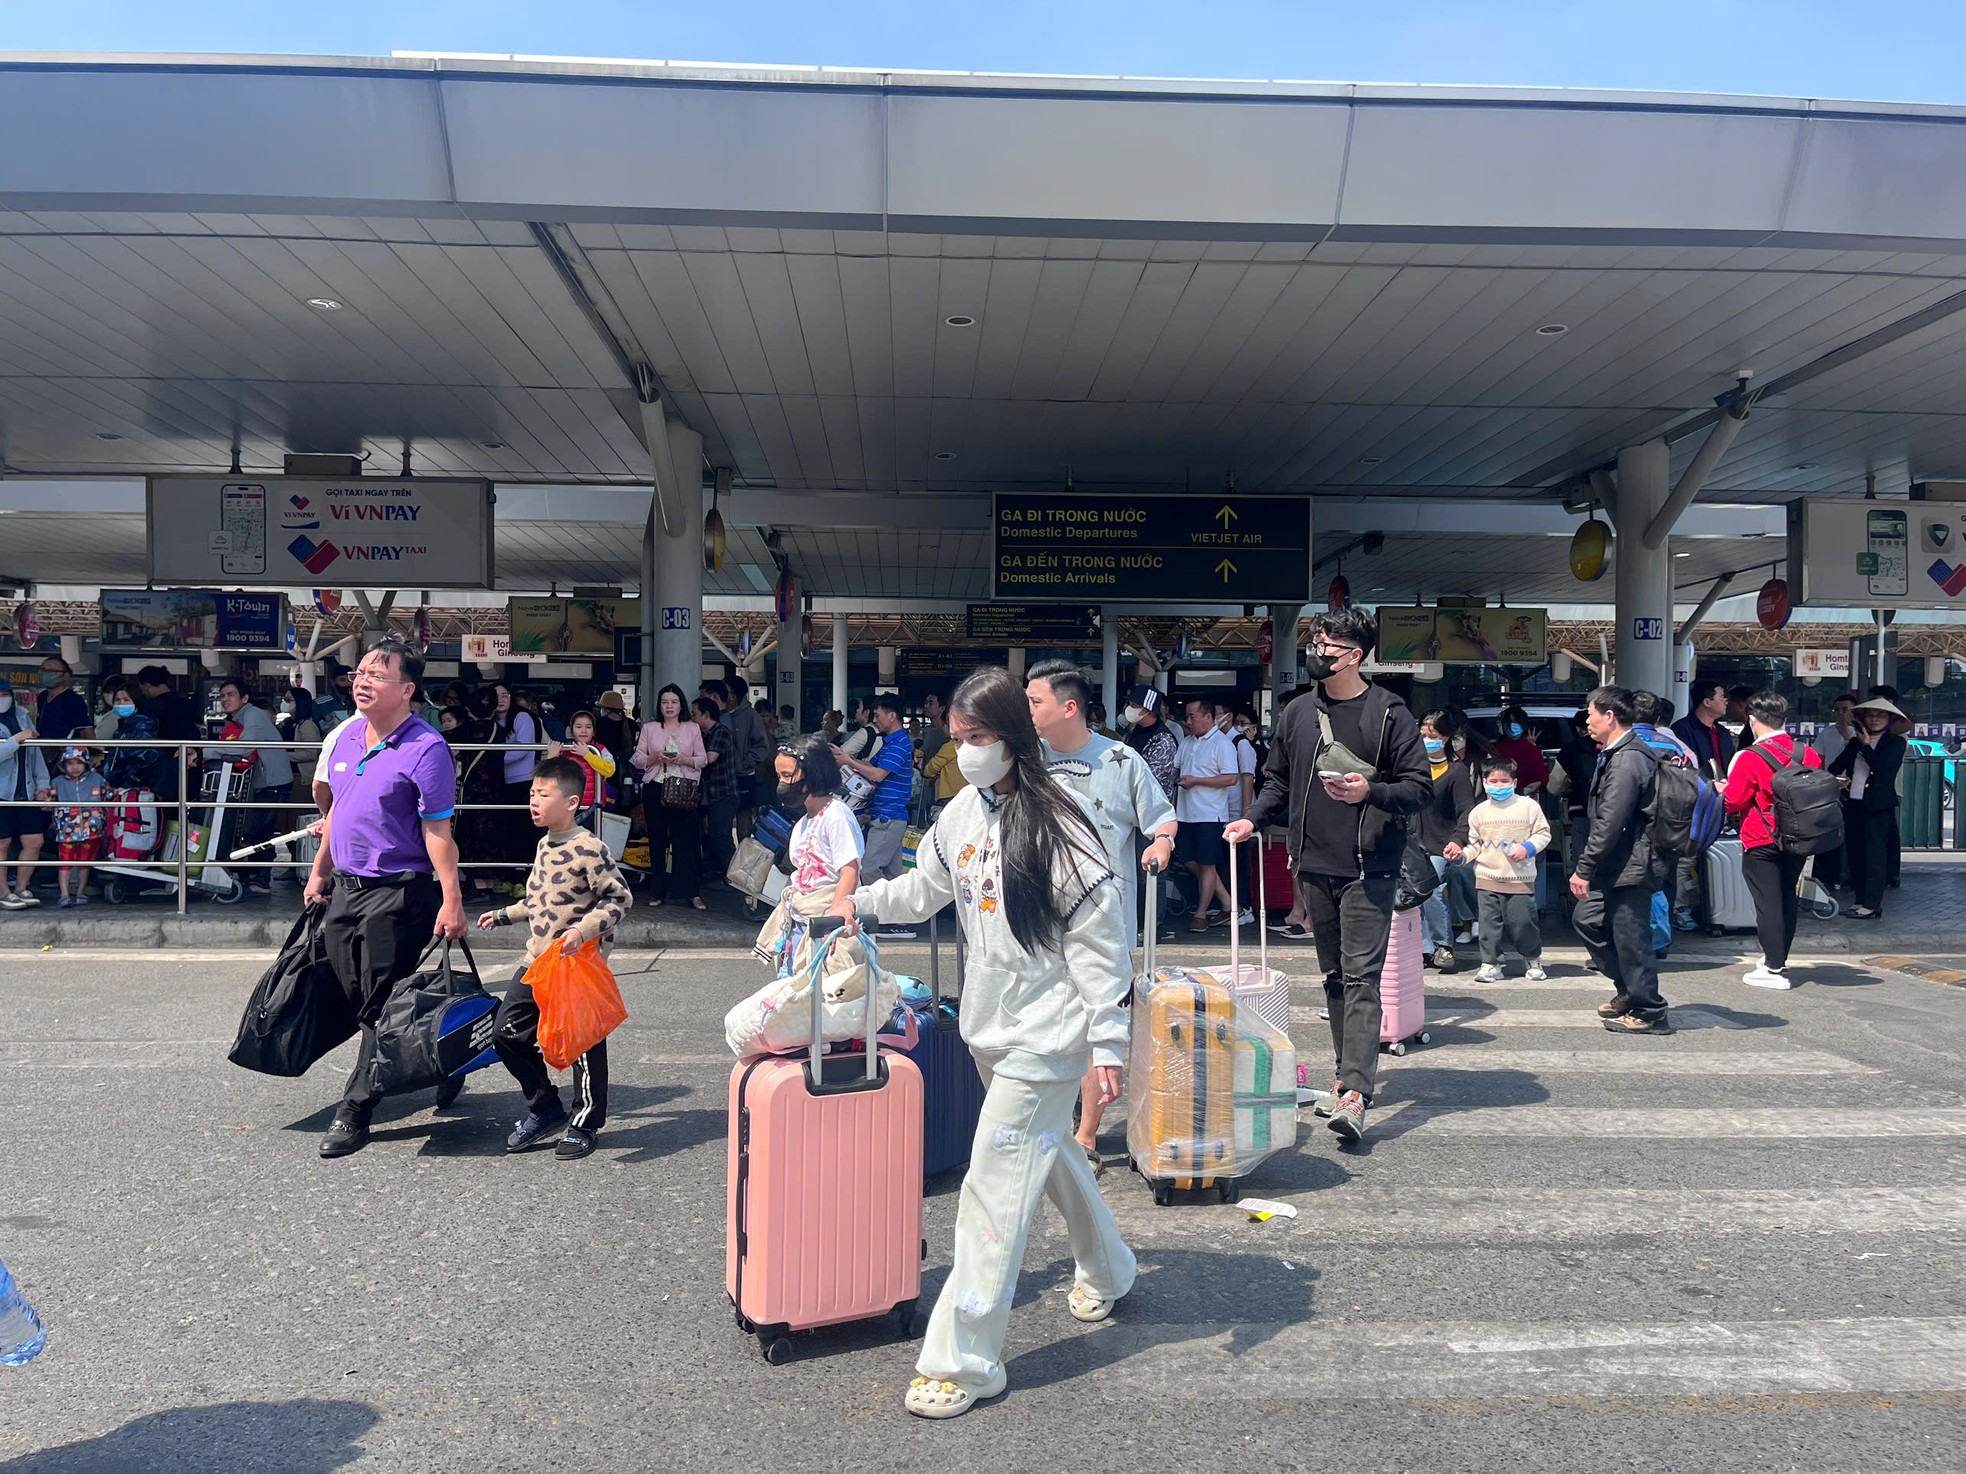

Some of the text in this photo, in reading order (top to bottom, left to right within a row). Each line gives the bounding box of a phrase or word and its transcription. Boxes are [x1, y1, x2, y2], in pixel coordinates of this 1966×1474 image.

[325, 487, 412, 498] GỌI TAXI NGAY TRÊN
[354, 505, 422, 521] VNPAY
[1001, 507, 1147, 523] GA ĐI TRONG NƯỚC
[1000, 526, 1138, 540] Domestic Departures
[1190, 533, 1263, 544] VIETJET AIR
[343, 546, 427, 560] VNPAY TAXI
[1000, 551, 1164, 568] GA ĐẾN TRONG NƯỚC
[1000, 572, 1116, 584] Domestic Arrivals
[662, 609, 690, 628] C-03
[1634, 619, 1662, 638] C-02
